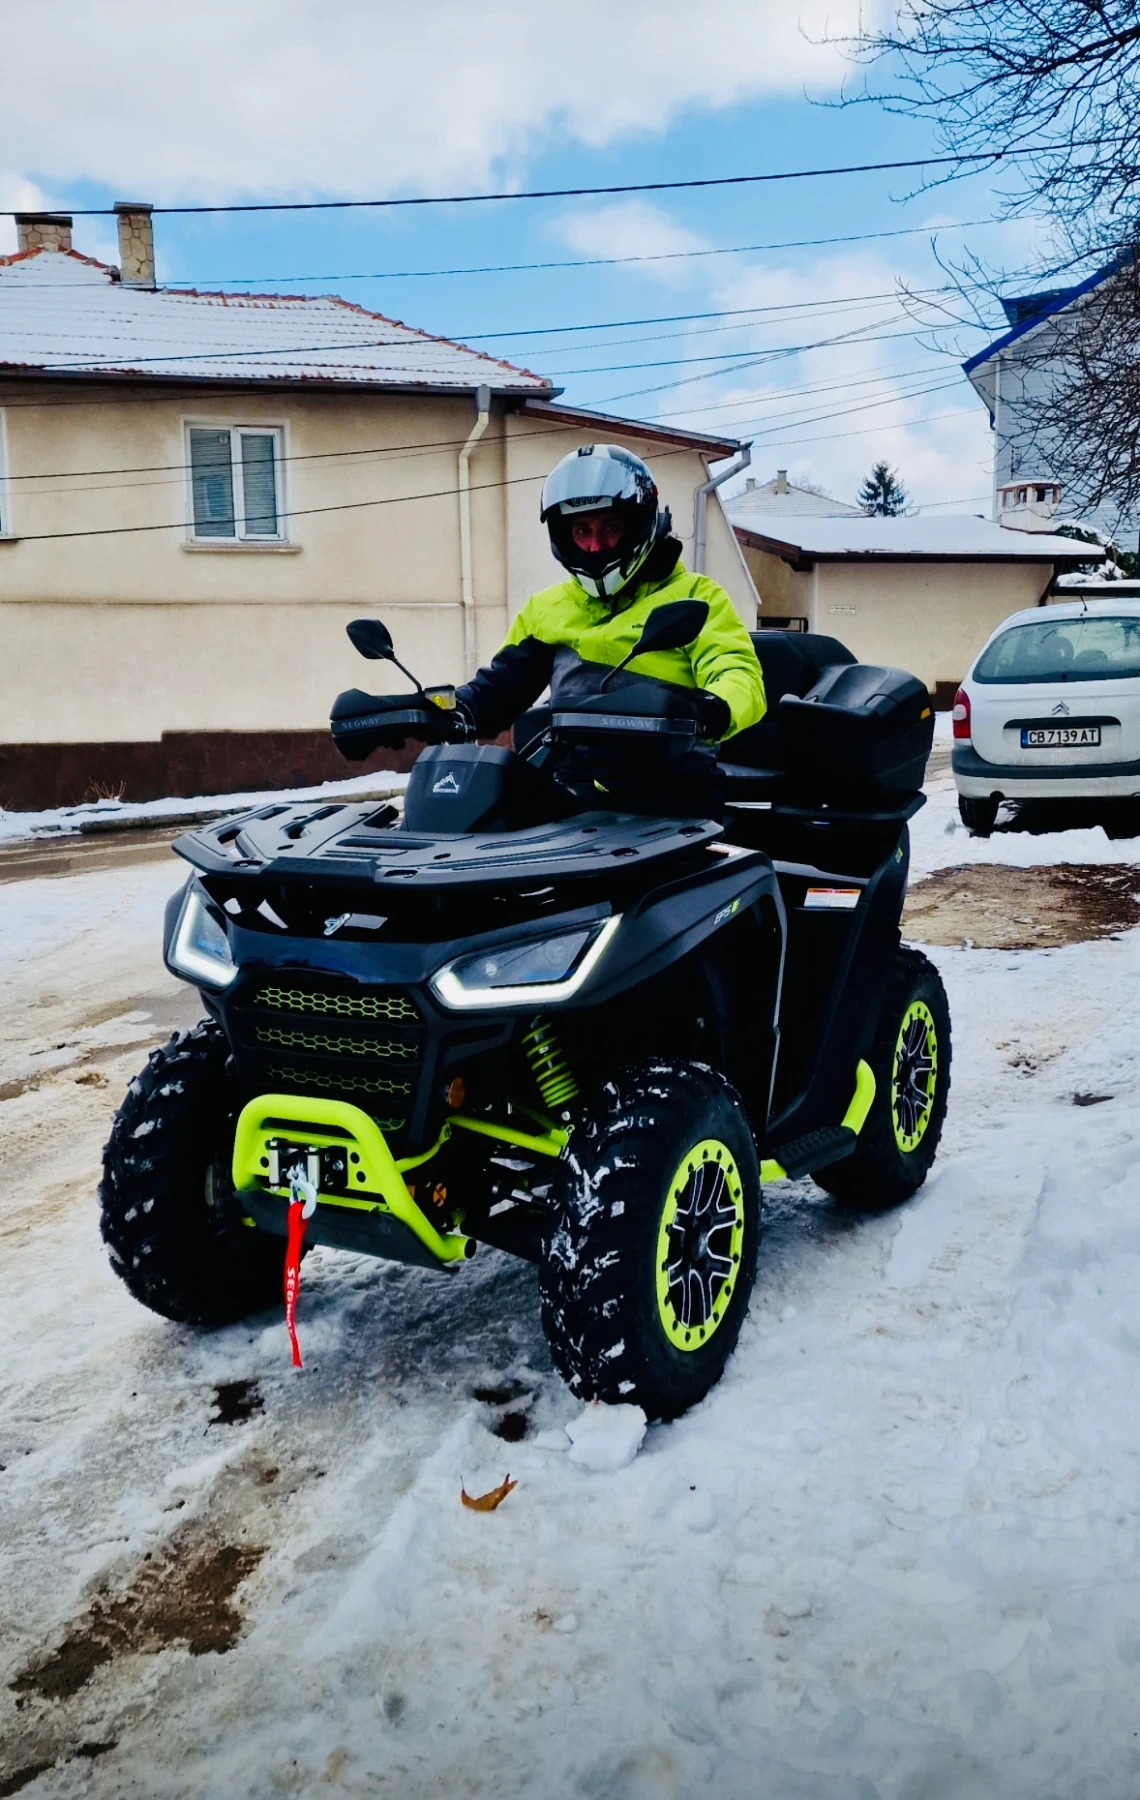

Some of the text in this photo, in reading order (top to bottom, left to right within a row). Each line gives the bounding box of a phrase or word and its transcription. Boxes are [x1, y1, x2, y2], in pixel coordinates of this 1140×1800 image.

[341, 717, 380, 729] SEGWAY
[600, 717, 652, 728] SEGWAY
[1029, 729, 1097, 744] CB 7139 AT
